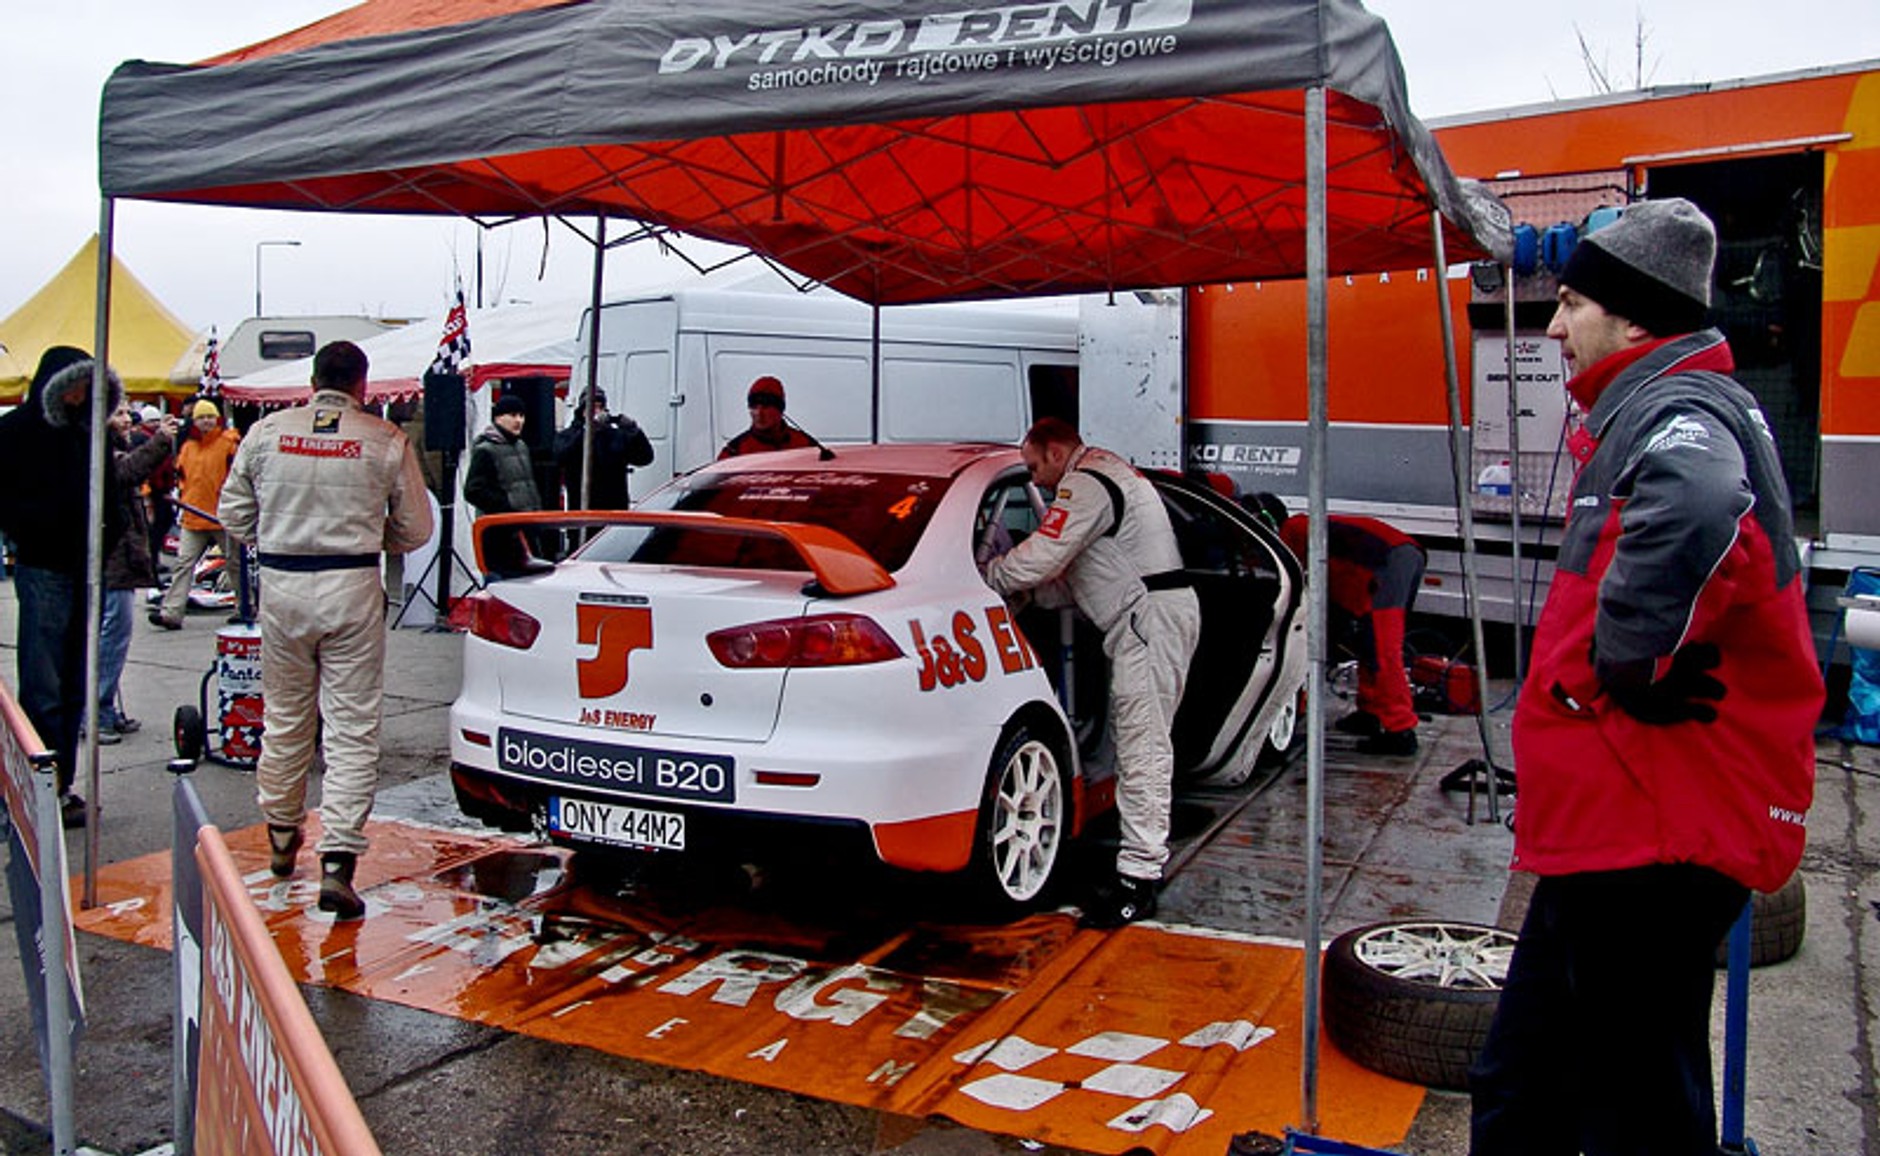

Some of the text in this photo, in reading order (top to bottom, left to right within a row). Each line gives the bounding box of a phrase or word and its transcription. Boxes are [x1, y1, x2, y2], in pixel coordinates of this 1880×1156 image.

[951, 0, 1142, 45] RENT
[747, 33, 1177, 91] samochody rajdowe i wyścigowe
[1233, 446, 1289, 462] RENT
[888, 495, 918, 520] 4
[908, 610, 987, 691] J&S
[604, 709, 657, 731] ENERGY
[505, 736, 725, 792] biodiesel B20
[563, 801, 684, 848] ONY 44M2
